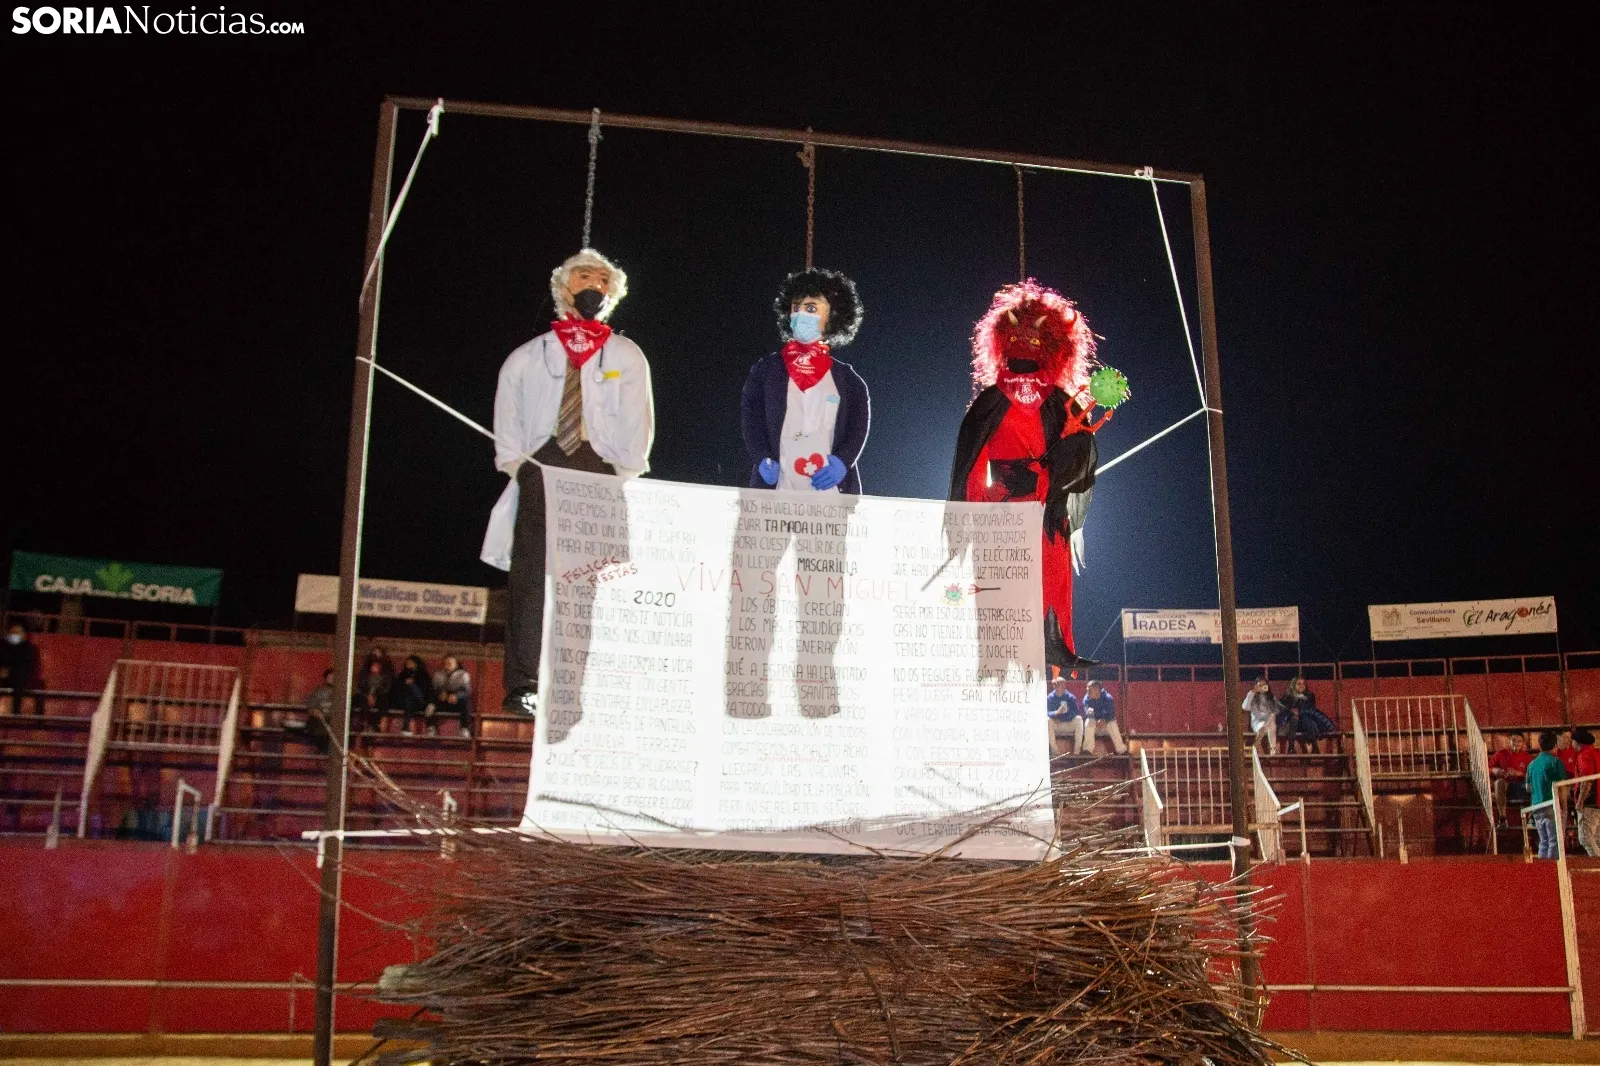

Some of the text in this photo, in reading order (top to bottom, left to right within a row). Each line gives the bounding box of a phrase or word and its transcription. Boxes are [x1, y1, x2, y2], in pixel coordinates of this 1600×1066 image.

[557, 498, 606, 518] VOLVEMOS
[611, 506, 616, 519] A
[740, 498, 822, 516] NOS HA VUELTO UNA
[944, 512, 959, 526] DEL
[558, 518, 571, 532] HA
[602, 524, 614, 538] UN
[659, 530, 696, 544] ESPERA
[764, 519, 808, 534] TAPADA
[810, 521, 822, 535] LA
[826, 522, 868, 538] MEJILLA
[956, 530, 988, 544] SACADO
[992, 530, 1026, 544] TAJADA
[556, 538, 629, 558] PARA RETOMAR
[825, 540, 834, 554] DE
[893, 544, 898, 558] Y
[902, 546, 917, 559] NO
[562, 556, 620, 584] FELICES
[587, 563, 638, 586] FIESTAS
[797, 557, 858, 574] MASCARILLA
[892, 562, 908, 576] QUE
[912, 563, 928, 576] HAN
[988, 566, 1004, 580] TAN
[1006, 566, 1029, 580] CARA
[677, 562, 743, 592] VIVA
[759, 570, 812, 596] SAN
[34, 574, 196, 604] CAJA SORIA
[556, 582, 568, 596] EN
[611, 588, 627, 603] DEL
[633, 590, 676, 608] 2020
[556, 601, 570, 616] NOS
[574, 602, 604, 620] DIERON
[618, 607, 649, 625] TRISTE
[740, 596, 758, 612] LOS
[892, 601, 916, 619] SERÁ
[919, 606, 933, 620] POR
[936, 606, 950, 620] ESO
[1004, 608, 1032, 622] CALLES
[738, 616, 756, 632] LOS
[788, 619, 865, 636] PERJUDICADOS
[1125, 610, 1196, 630] TRADESA
[555, 620, 564, 636] EL
[624, 628, 639, 644] NOS
[915, 624, 928, 638] NO
[930, 624, 962, 639] TIENEN
[725, 636, 766, 651] FUERON
[787, 638, 858, 656] GENERACIÓN
[894, 642, 927, 658] TENED
[972, 644, 984, 658] DE
[986, 644, 1019, 659] NOCHE
[629, 654, 655, 671] FORMA
[658, 657, 668, 673] DE
[724, 657, 867, 681] QUÉ A ESPAÑA HA LEVANTADO
[553, 669, 576, 685] NADA
[638, 677, 656, 692] CON
[892, 668, 906, 682] NO
[908, 668, 919, 682] OS
[552, 690, 574, 705] NADA
[592, 692, 632, 710] SENTARSE
[780, 684, 797, 698] LOS
[892, 688, 919, 702] PERO
[960, 688, 983, 702] SAN
[990, 689, 1030, 704] MIGUEL
[739, 702, 766, 717] TODO
[634, 716, 644, 731] DE
[650, 717, 696, 734] PANTALLAS
[722, 720, 739, 736] CON
[824, 724, 832, 738] DE
[838, 725, 867, 739] TODOS
[593, 734, 624, 749] NUEVA
[636, 736, 686, 752] TERRAZA
[930, 746, 982, 760] FESTEJOS
[782, 764, 802, 778] LAS
[809, 764, 858, 778] VACUNAS
[989, 768, 1020, 781] 2022
[719, 781, 740, 794] PARA
[896, 823, 916, 836] QUE
